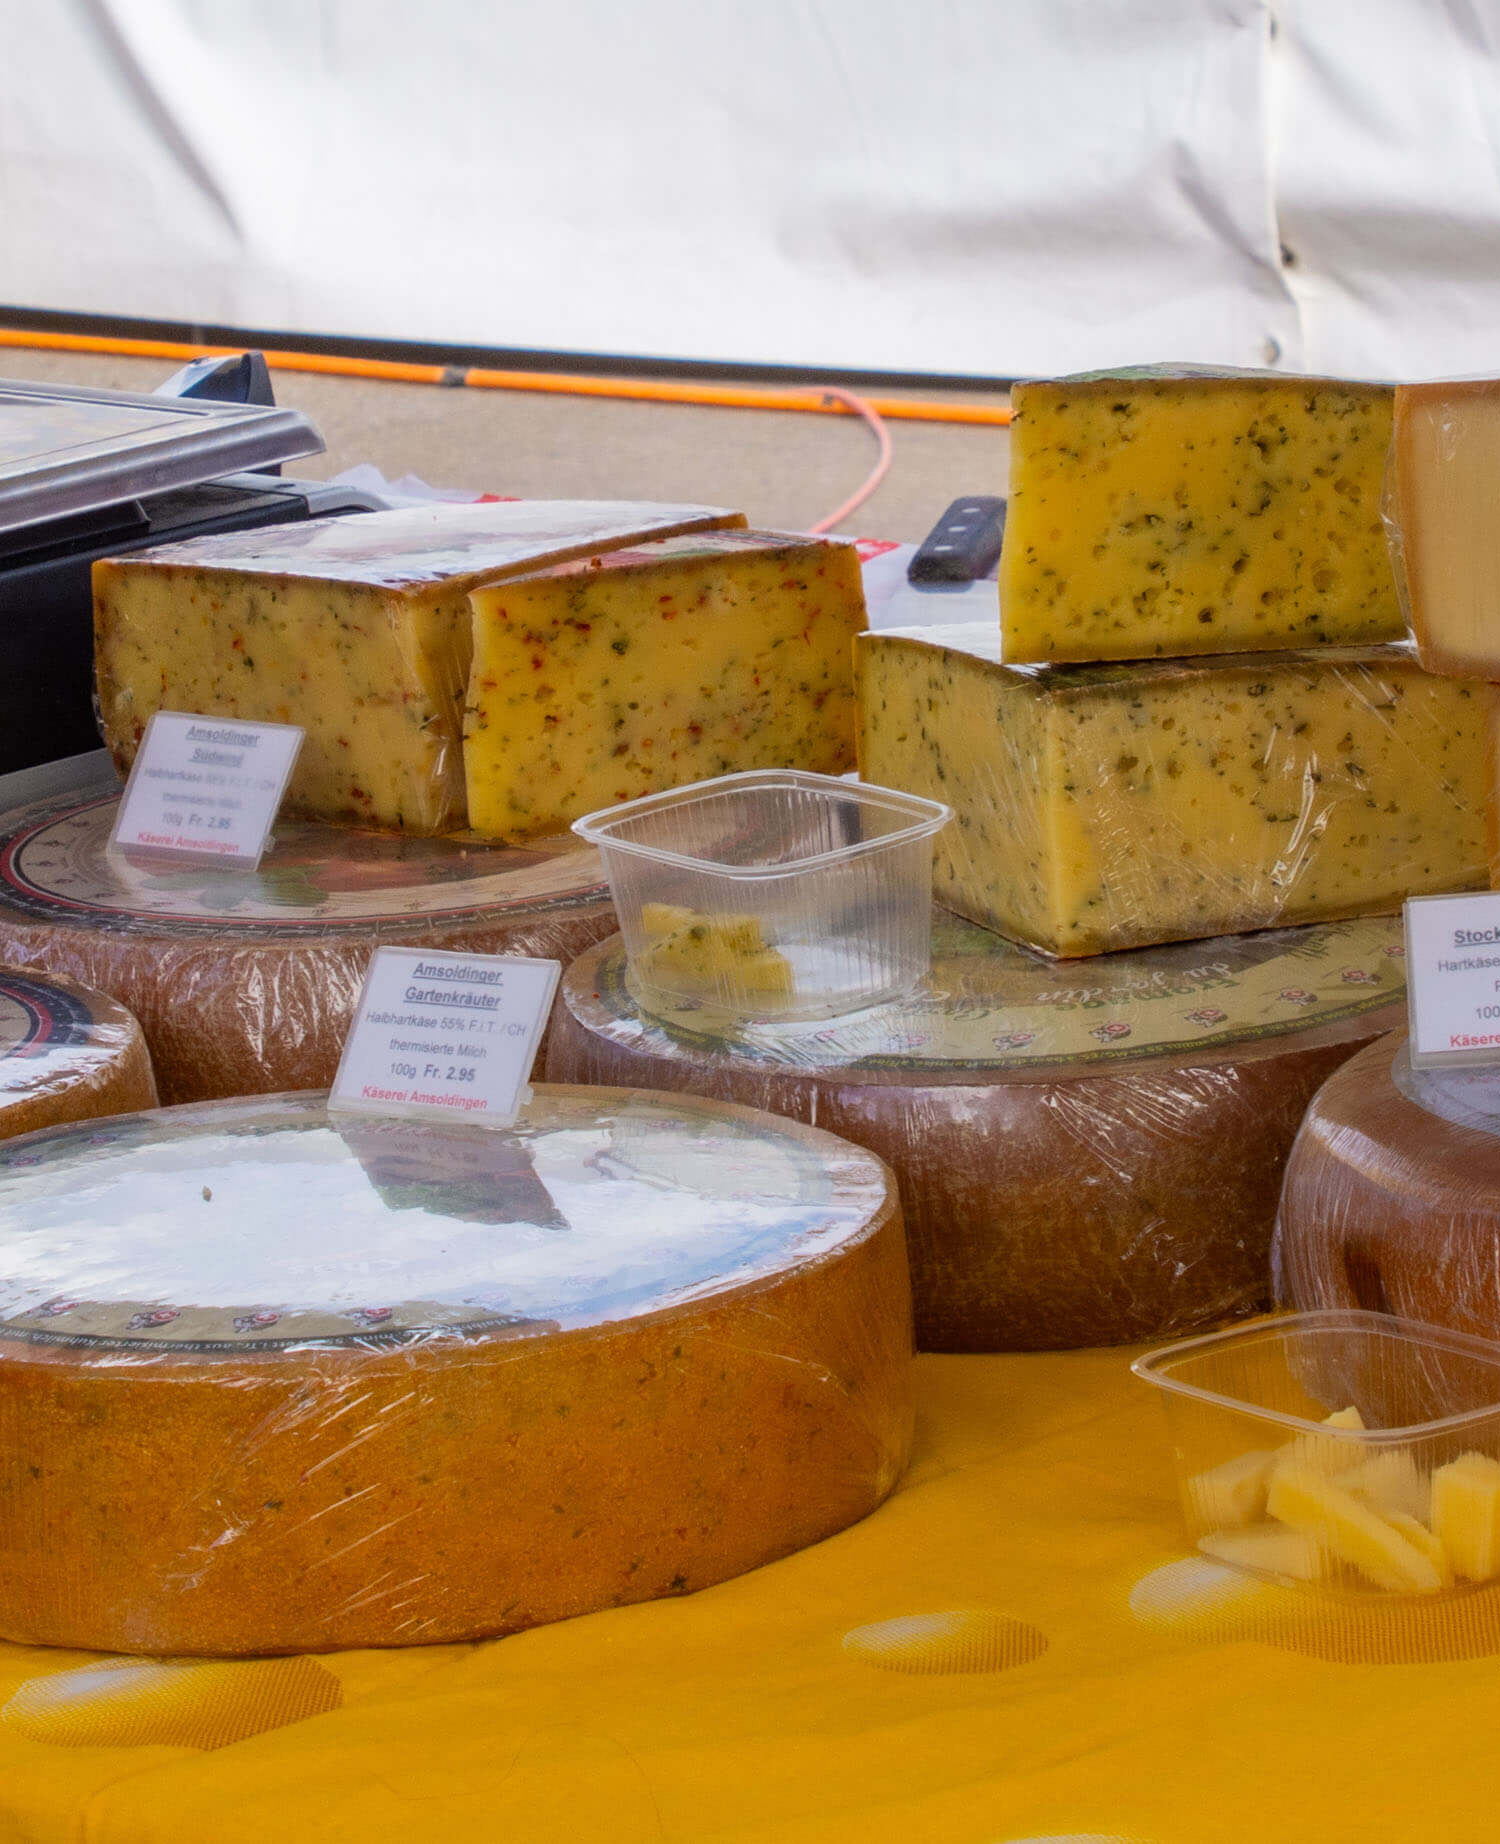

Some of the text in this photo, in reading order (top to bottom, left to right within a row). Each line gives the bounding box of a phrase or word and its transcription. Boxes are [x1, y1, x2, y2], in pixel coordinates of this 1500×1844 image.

[187, 727, 260, 746] Amsoldinger
[137, 832, 174, 847] Käserei
[413, 962, 503, 983] Amsoldinger
[1437, 953, 1500, 973] Hartkäse
[405, 986, 501, 1008] Gartenkräuter
[366, 1011, 438, 1029] Halbhartkäse
[440, 1016, 465, 1031] 55%
[507, 1023, 528, 1037] CH
[390, 1038, 487, 1059] thermisierte Milch
[390, 1062, 476, 1082] 100g Fr. 2.95
[362, 1085, 488, 1111] Käserei Amsoldingen
[31, 1333, 98, 1348] Kuhmilch
